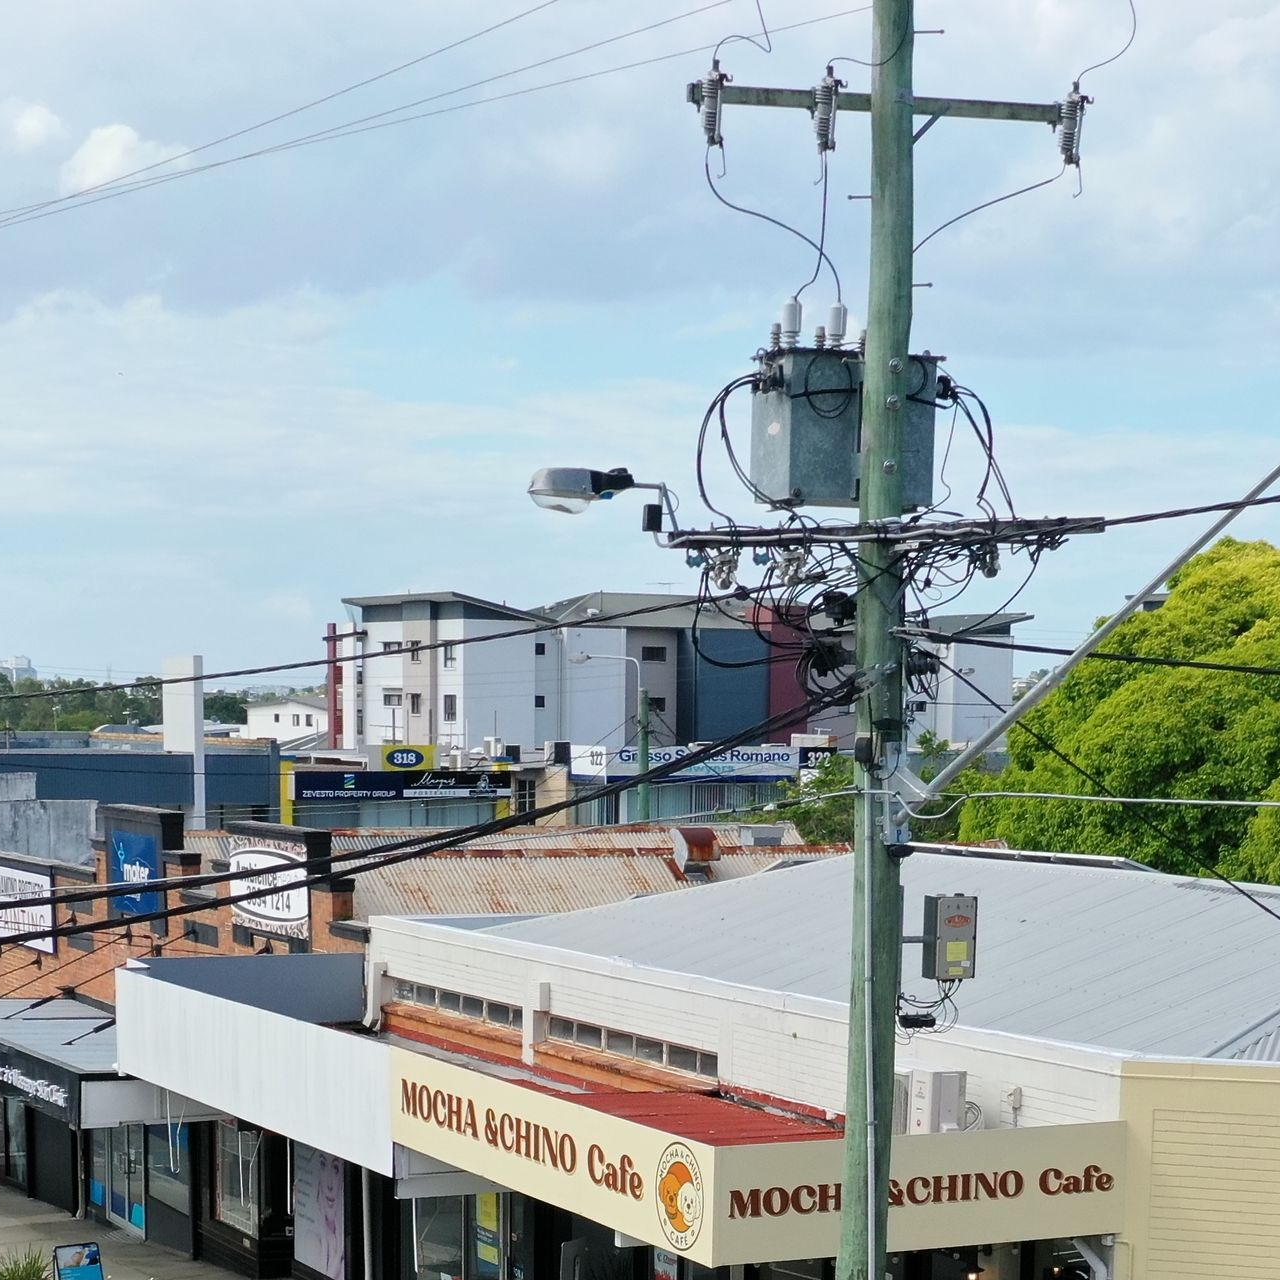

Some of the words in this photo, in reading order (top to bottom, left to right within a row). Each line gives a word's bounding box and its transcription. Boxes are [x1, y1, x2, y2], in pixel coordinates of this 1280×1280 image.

[394, 753, 416, 765] 318
[590, 750, 602, 765] 322
[619, 750, 672, 762] Grsso
[730, 749, 790, 762] Romano
[808, 751, 831, 767] 322
[686, 763, 735, 774] awyers
[302, 790, 334, 798] ZEVESTO
[335, 790, 371, 798] PROPERTY
[373, 790, 397, 798] GROUP
[400, 1078, 480, 1141] MOCHA
[587, 1143, 644, 1200] Cafe
[659, 1148, 679, 1178] MOCHA
[684, 1154, 701, 1192] CHINO
[728, 1183, 842, 1219] MOCH
[1038, 1164, 1115, 1196] Cafe
